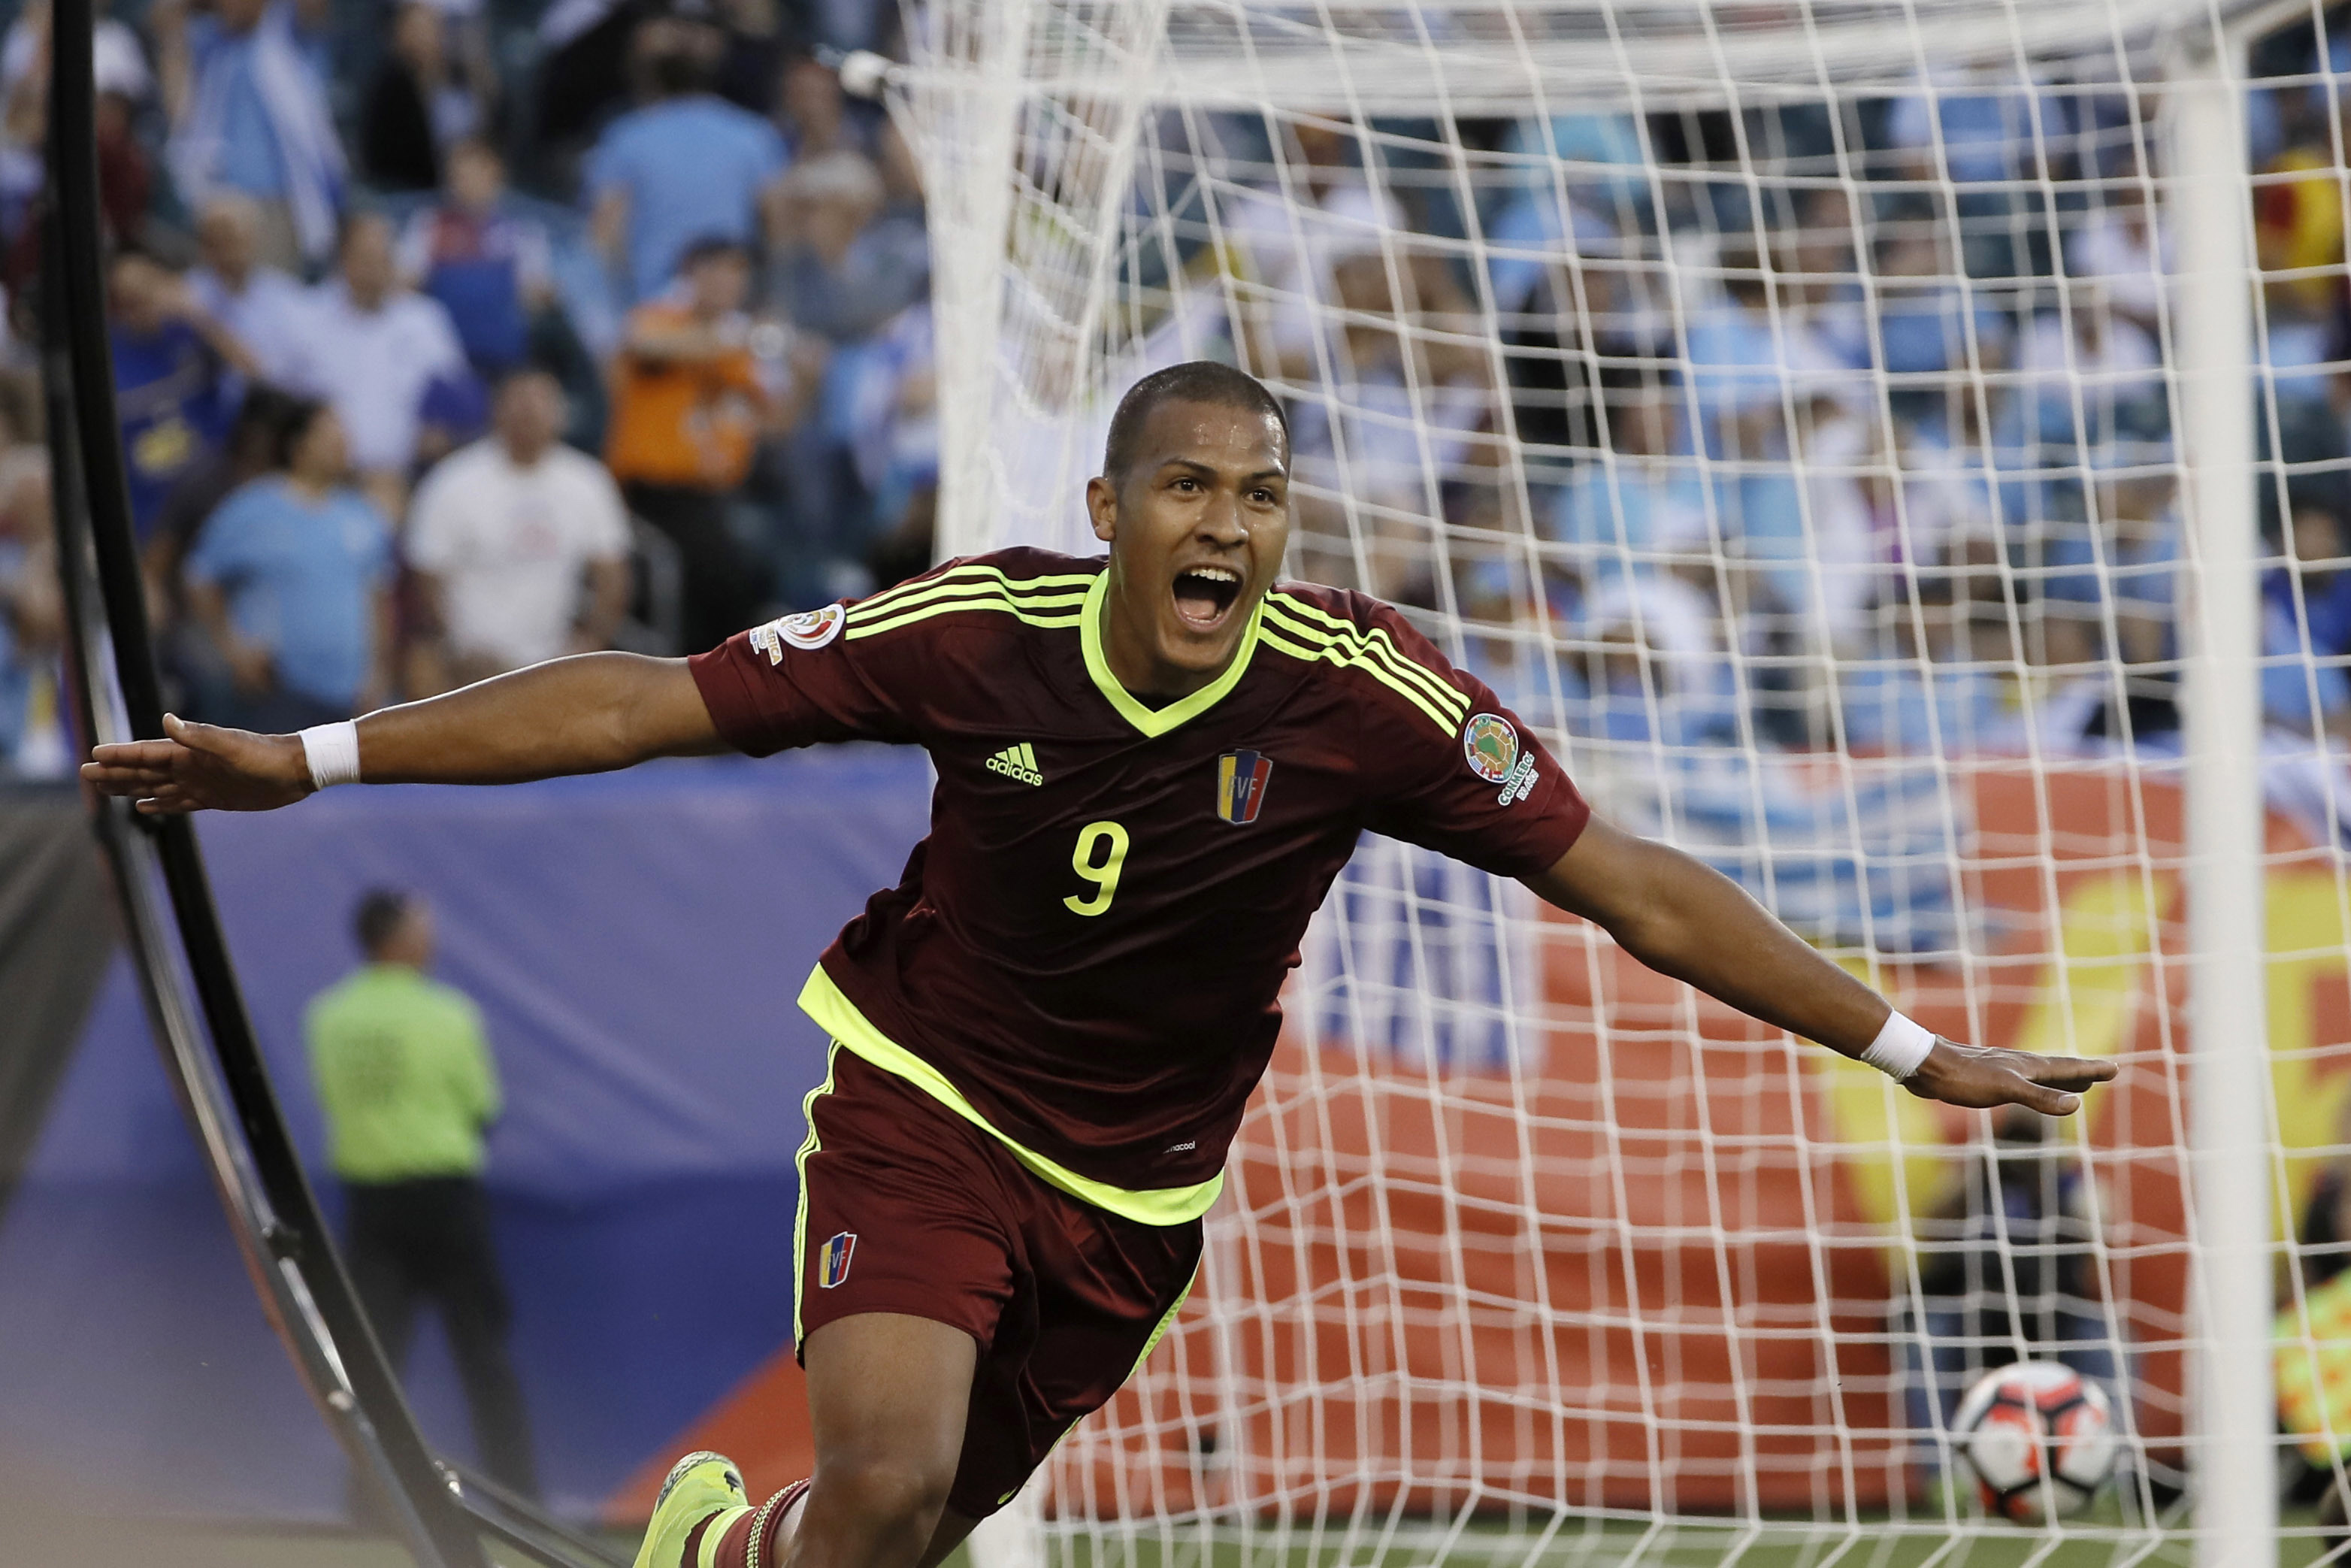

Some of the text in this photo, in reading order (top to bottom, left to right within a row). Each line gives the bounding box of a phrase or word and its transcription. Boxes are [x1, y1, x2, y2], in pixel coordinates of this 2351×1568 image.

[985, 758, 1043, 786] adidas
[1227, 776, 1258, 800] FVF
[1499, 752, 1534, 804] CONMEBOL
[1063, 821, 1130, 916] 9
